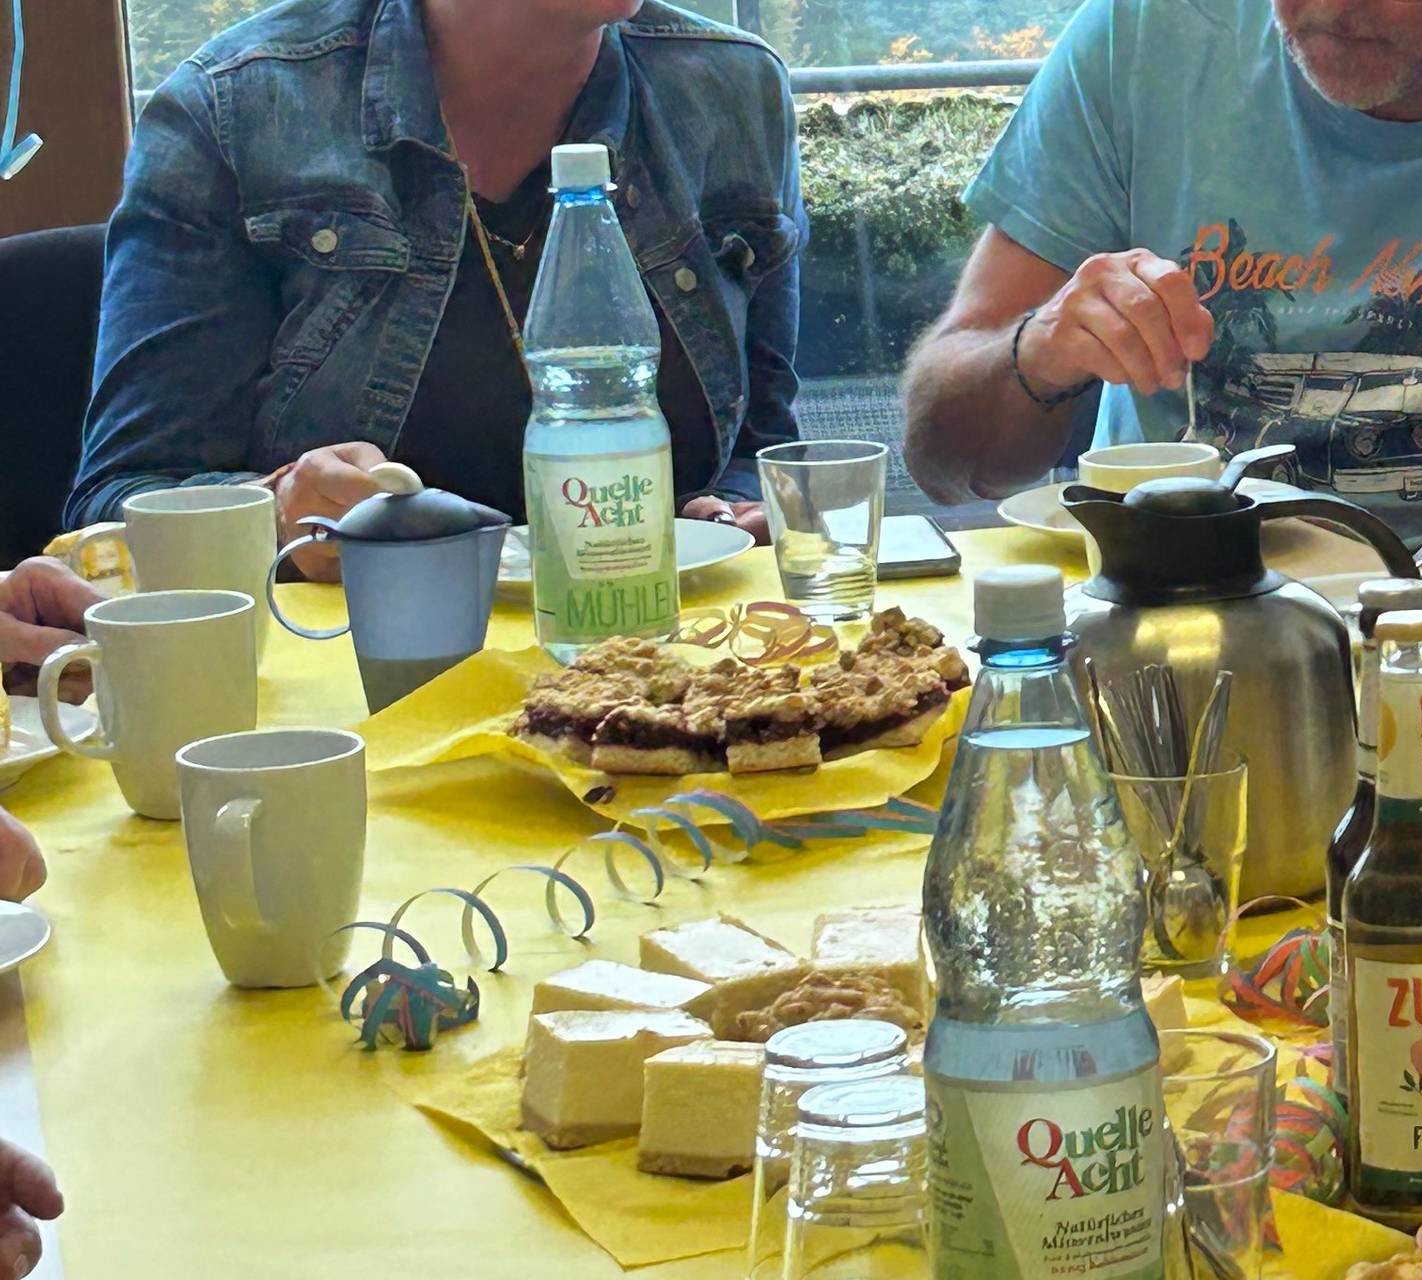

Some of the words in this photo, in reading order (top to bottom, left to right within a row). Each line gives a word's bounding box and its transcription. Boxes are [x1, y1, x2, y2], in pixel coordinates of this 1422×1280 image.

[1189, 222, 1335, 301] Beach
[561, 474, 653, 508] Quelle
[577, 500, 645, 528] Acht
[1016, 1104, 1154, 1168] Quelle
[1044, 1148, 1145, 1201] Acht
